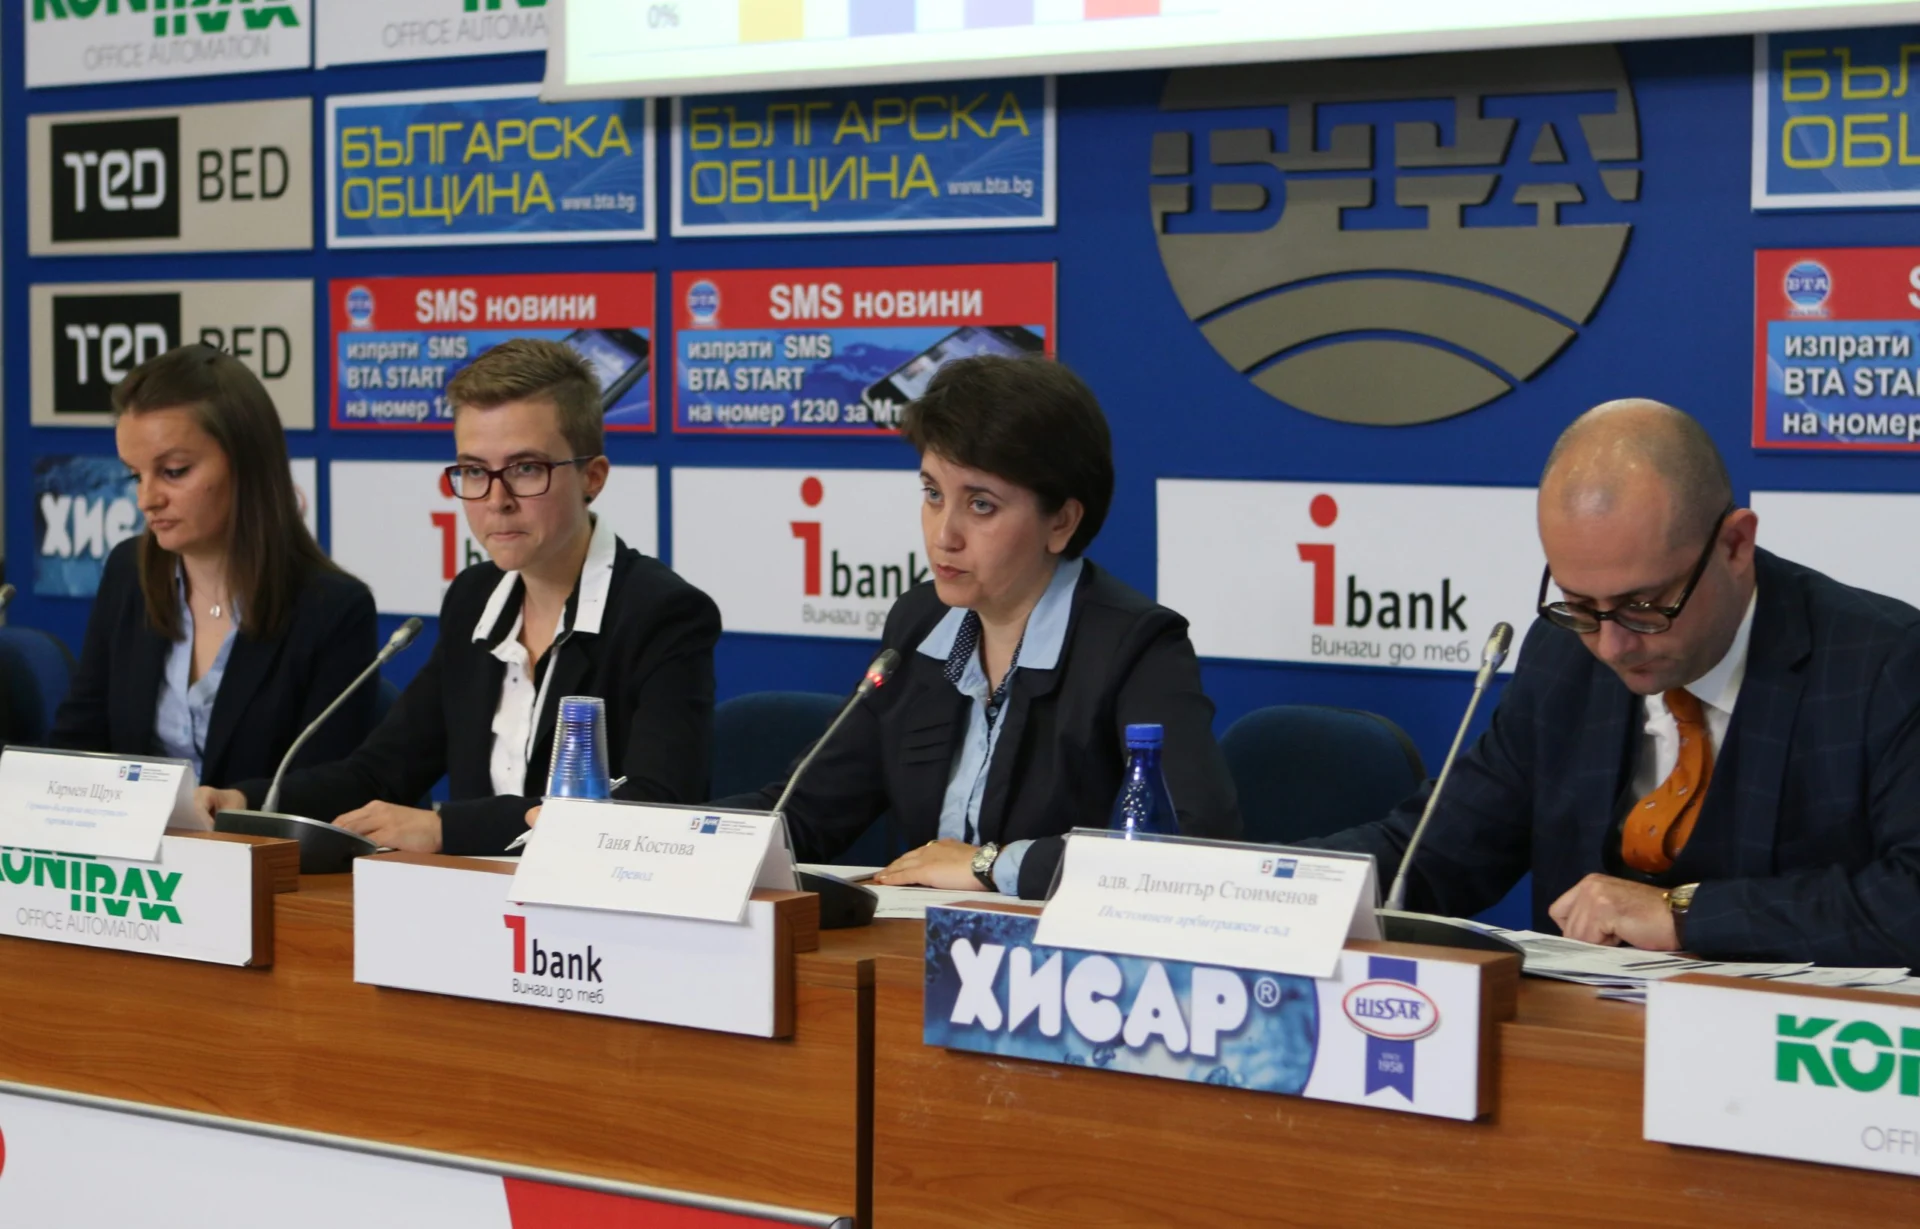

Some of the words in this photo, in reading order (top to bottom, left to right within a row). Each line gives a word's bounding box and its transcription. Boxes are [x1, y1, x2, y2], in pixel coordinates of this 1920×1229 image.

[646, 4, 680, 29] 0%
[382, 18, 452, 48] OFFICE
[82, 43, 144, 70] OFFICE
[149, 34, 270, 66] AUTOMATION
[690, 92, 1031, 151] БЪЛГАРСКА
[341, 114, 632, 169] БЪЛГАРСКА
[198, 145, 290, 203] BED
[690, 153, 939, 212] ОБЩИНА
[947, 175, 1034, 200] www.bta.bg
[341, 170, 556, 226] ОБЩИНА
[561, 193, 637, 214] www.bta.bg
[415, 288, 477, 323] SMS
[485, 294, 597, 322] новини
[769, 283, 843, 320] SMS
[853, 289, 983, 319] новини
[346, 341, 420, 364] изпрати
[428, 336, 469, 360] SMS
[688, 340, 773, 364] изпрати
[784, 334, 832, 360] SMS
[1785, 335, 1910, 364] изпрати
[386, 366, 446, 390] START
[734, 367, 806, 391] START
[346, 399, 367, 419] на
[371, 400, 429, 422] номер
[688, 404, 712, 423] на
[717, 404, 785, 427] номер
[791, 399, 839, 423] 1230
[844, 404, 868, 423] за
[1783, 412, 1818, 434] на
[1311, 634, 1381, 660] Винаги
[47, 780, 88, 800] Кармен
[90, 783, 124, 803] Щрук
[597, 833, 631, 851] Таня
[633, 836, 696, 856] Костова
[611, 866, 654, 882] Превод
[1097, 873, 1131, 890] адв.
[1135, 873, 1214, 900] Димитър
[1219, 880, 1319, 906] Стоименов
[16, 907, 63, 931] OFFICE
[66, 915, 160, 943] AUTOMATION
[512, 978, 554, 998] Винаги
[950, 937, 1249, 1057] ХИСАР
[1355, 997, 1421, 1021] HISSAR
